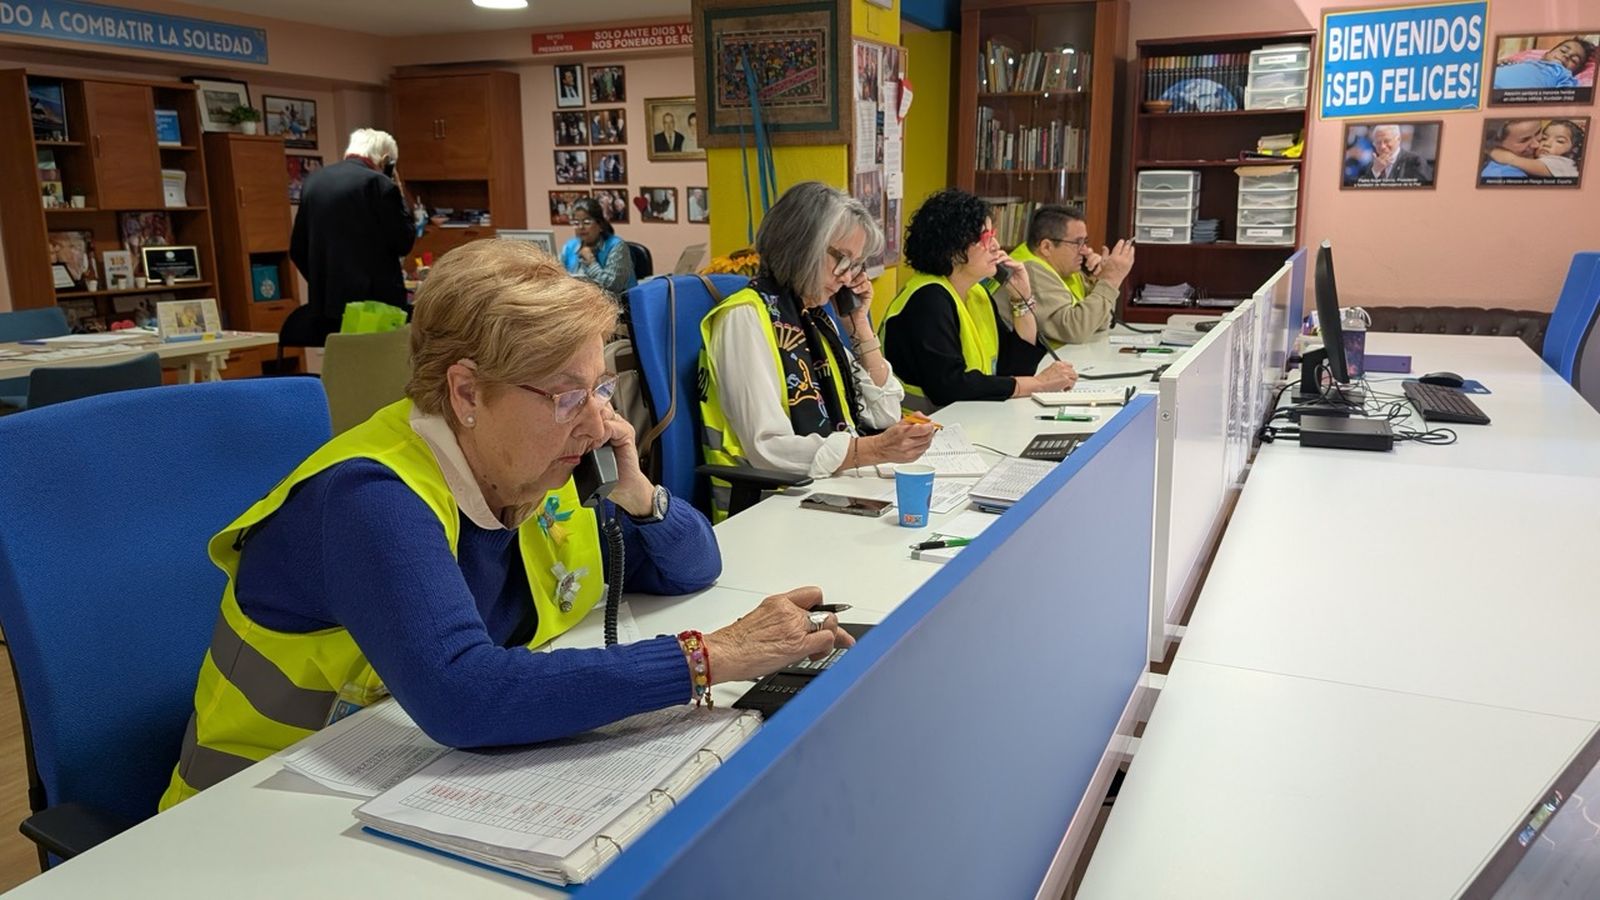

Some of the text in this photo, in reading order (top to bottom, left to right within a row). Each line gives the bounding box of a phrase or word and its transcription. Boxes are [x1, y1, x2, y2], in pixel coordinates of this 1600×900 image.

[0, 2, 252, 55] DO A COMBATIR LA SOLEDAD
[592, 40, 612, 50] NOS
[614, 35, 663, 48] PONEMOS
[665, 35, 679, 45] DE
[595, 30, 622, 40] SOLO
[624, 27, 649, 38] ANTE
[652, 25, 675, 36] DIOS
[677, 25, 685, 34] Y
[1328, 15, 1481, 62] BIENVENIDOS
[1326, 62, 1479, 107] ¡SED FELICES!
